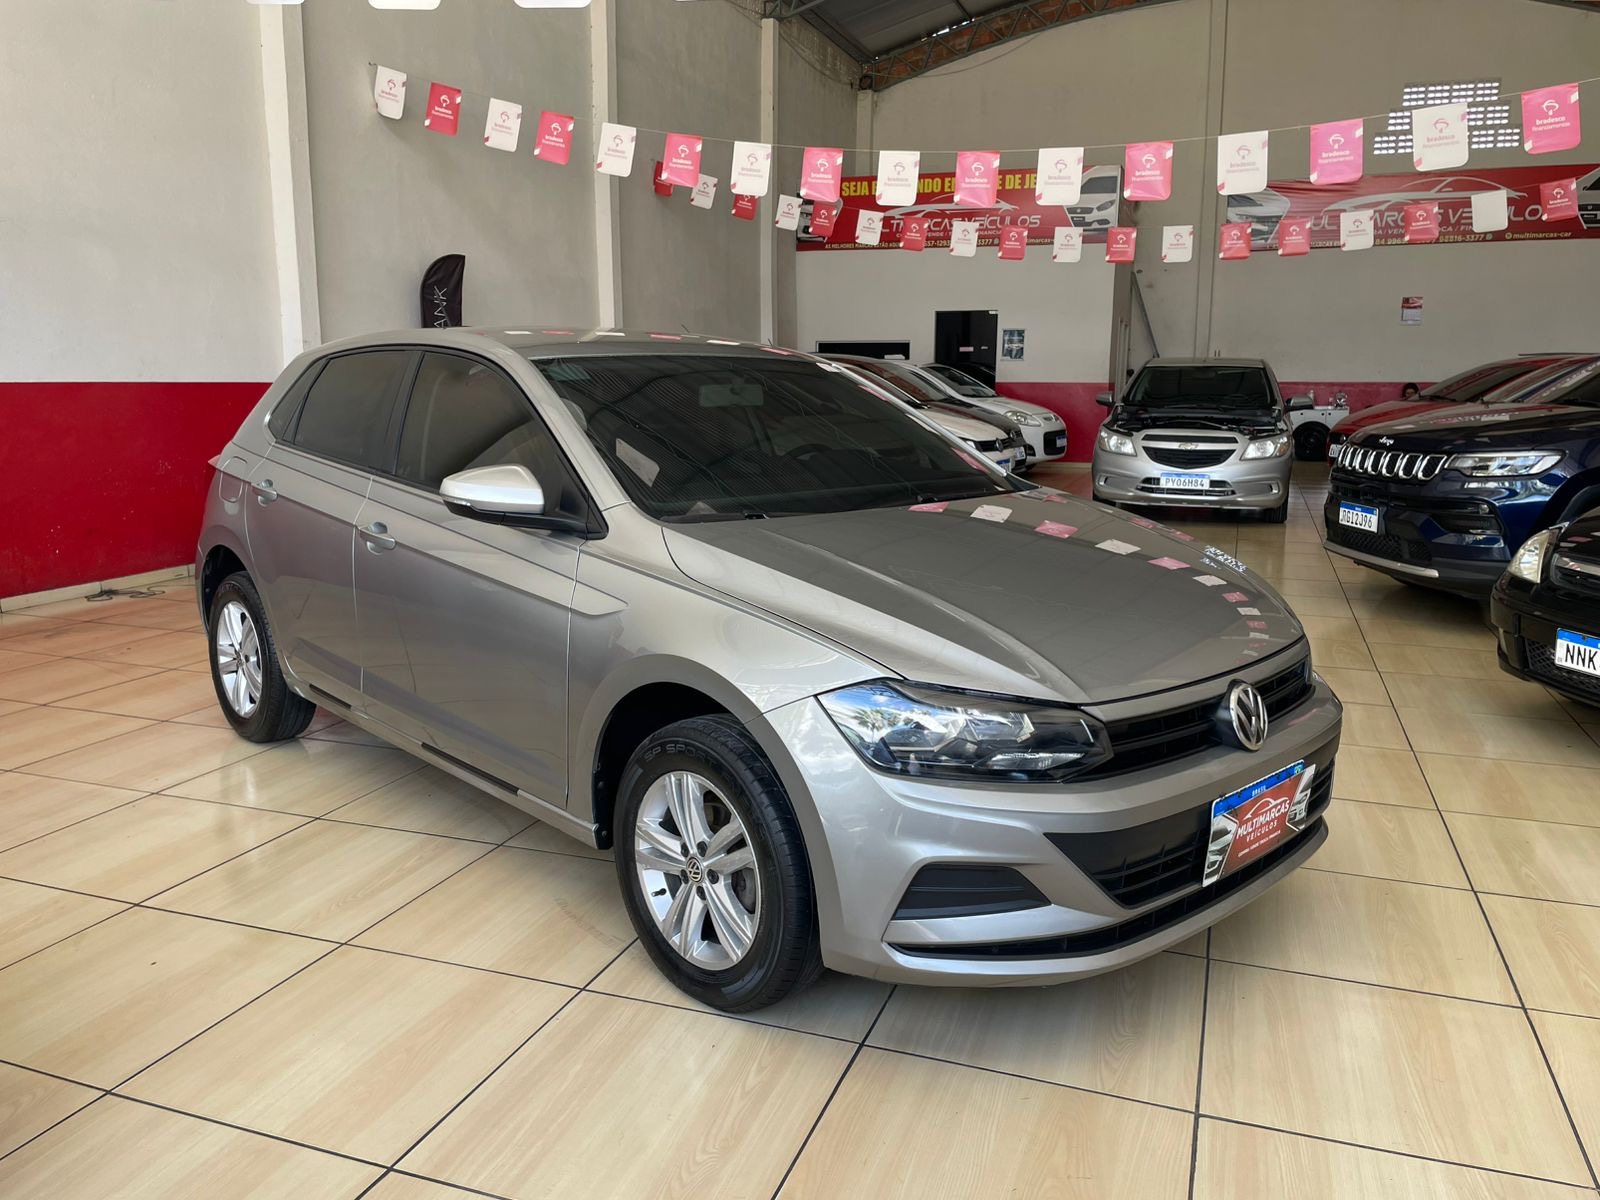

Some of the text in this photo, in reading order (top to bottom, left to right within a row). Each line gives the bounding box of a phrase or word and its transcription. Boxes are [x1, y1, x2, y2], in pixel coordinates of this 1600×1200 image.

[1535, 116, 1566, 125] bradesco
[842, 182, 869, 196] SEJA
[1005, 174, 1022, 190] DE
[1564, 643, 1598, 671] NNK
[1235, 800, 1290, 840] MULTIMARCAS
